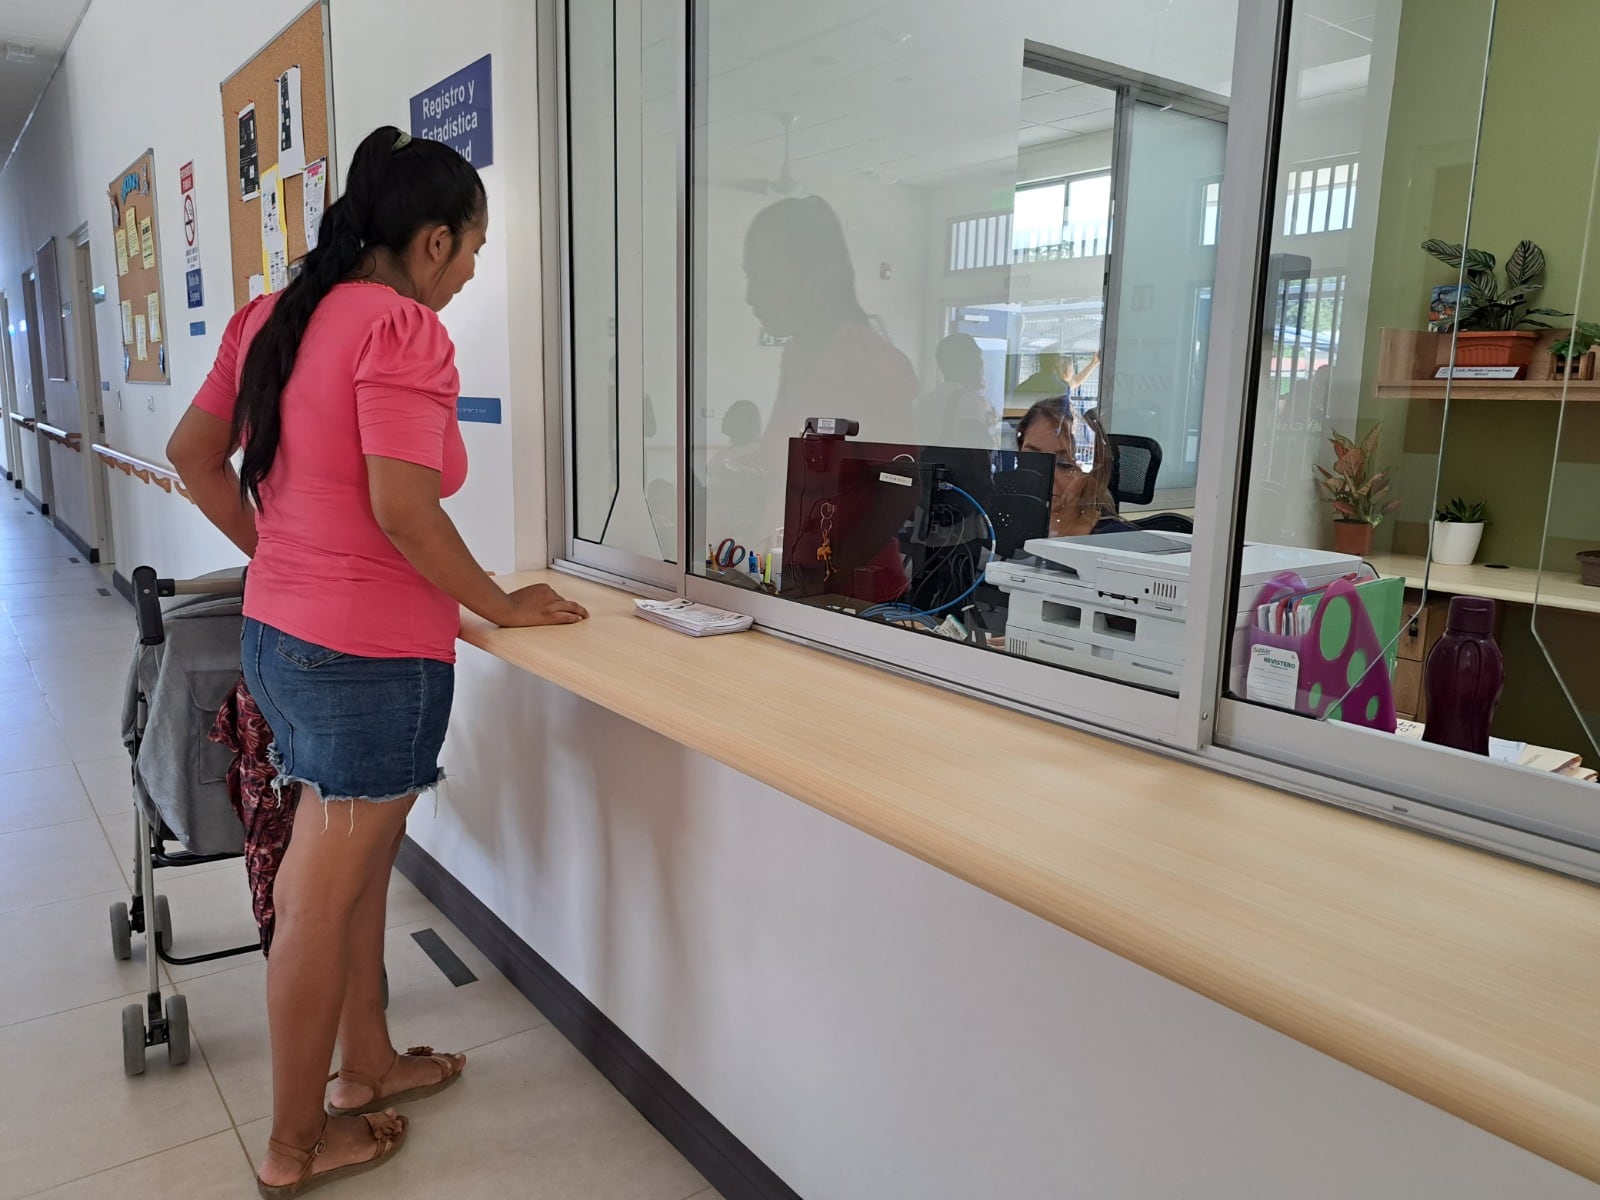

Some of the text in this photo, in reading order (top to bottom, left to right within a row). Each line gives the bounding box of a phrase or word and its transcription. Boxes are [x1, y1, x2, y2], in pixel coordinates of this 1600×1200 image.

[422, 79, 475, 120] Registro y
[1263, 657, 1296, 670] REVISTERO
